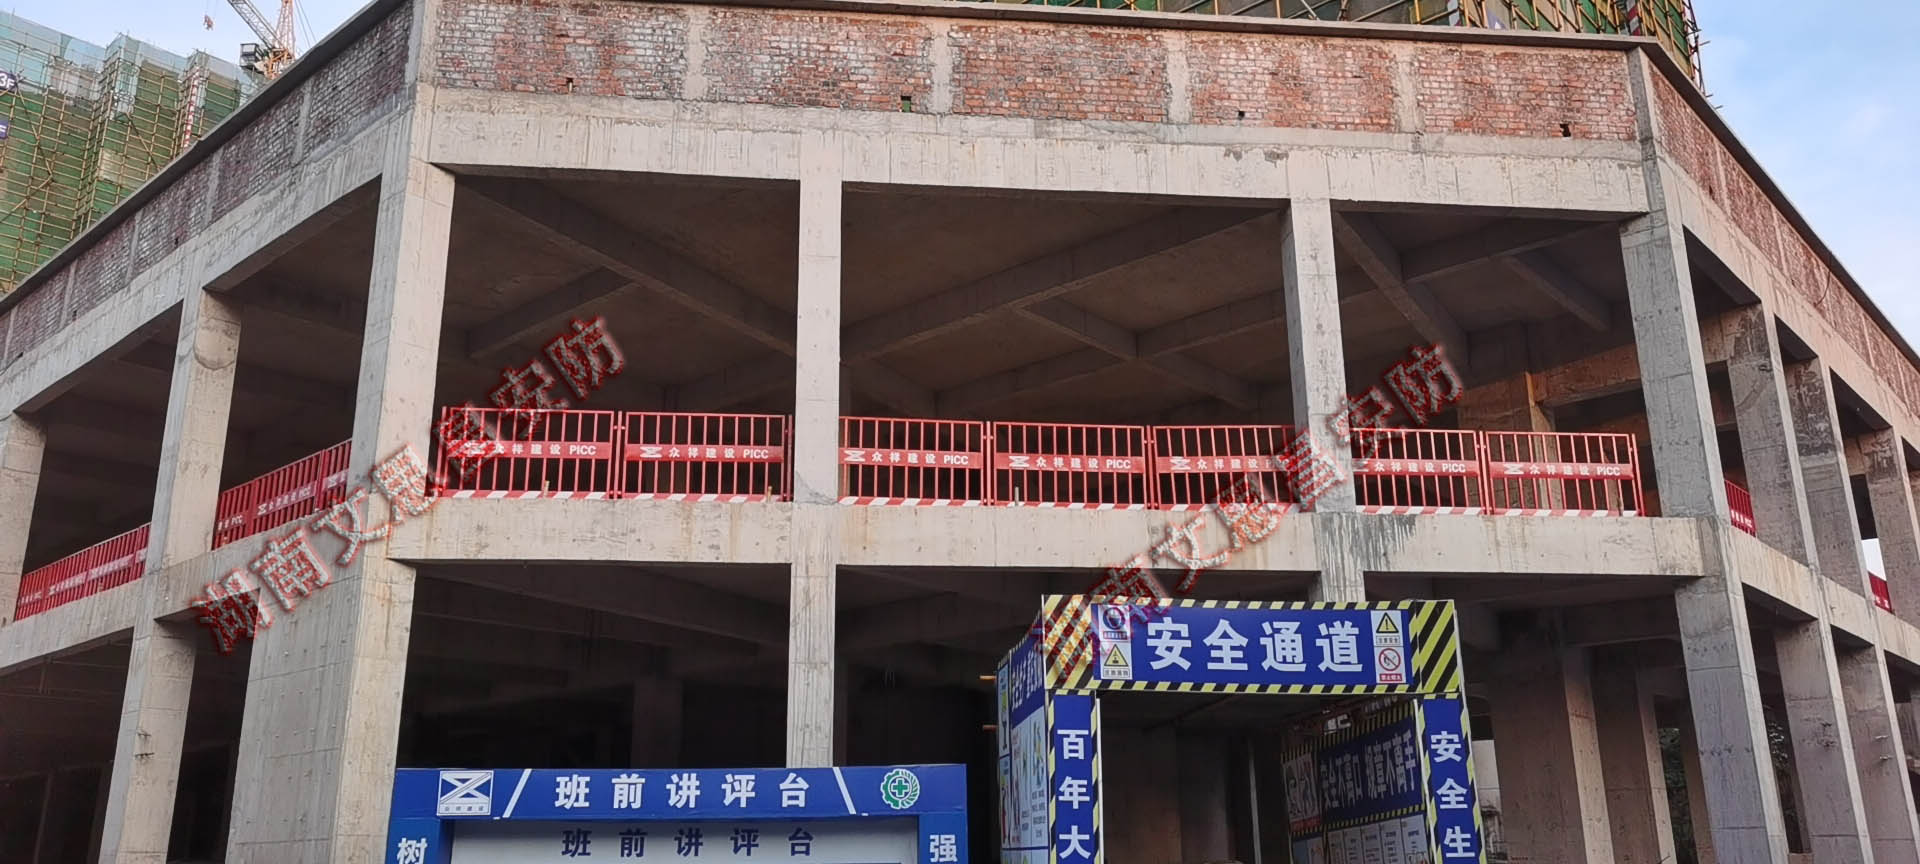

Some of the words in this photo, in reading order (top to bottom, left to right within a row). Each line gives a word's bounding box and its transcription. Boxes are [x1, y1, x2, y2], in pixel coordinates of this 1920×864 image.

[569, 444, 597, 455] PICC
[668, 447, 735, 459] 众祥建设
[743, 449, 769, 459] PICC
[872, 452, 936, 464] 众祥建设
[943, 454, 969, 465] PICC
[1036, 456, 1098, 469] 众祥建设
[1106, 459, 1132, 469] PICC
[1197, 459, 1258, 469] 众祥建设
[1375, 462, 1435, 472] 众祥建设
[1442, 463, 1466, 473] PICC
[1596, 466, 1621, 476] PICC
[1147, 617, 1363, 672] 安全通道
[555, 773, 810, 809] 班前讲评台
[1057, 729, 1091, 860] 百年大
[1430, 731, 1476, 859] 安全生
[397, 838, 428, 864] 树
[561, 828, 814, 858] 班前讲评台
[929, 834, 958, 863] 强
